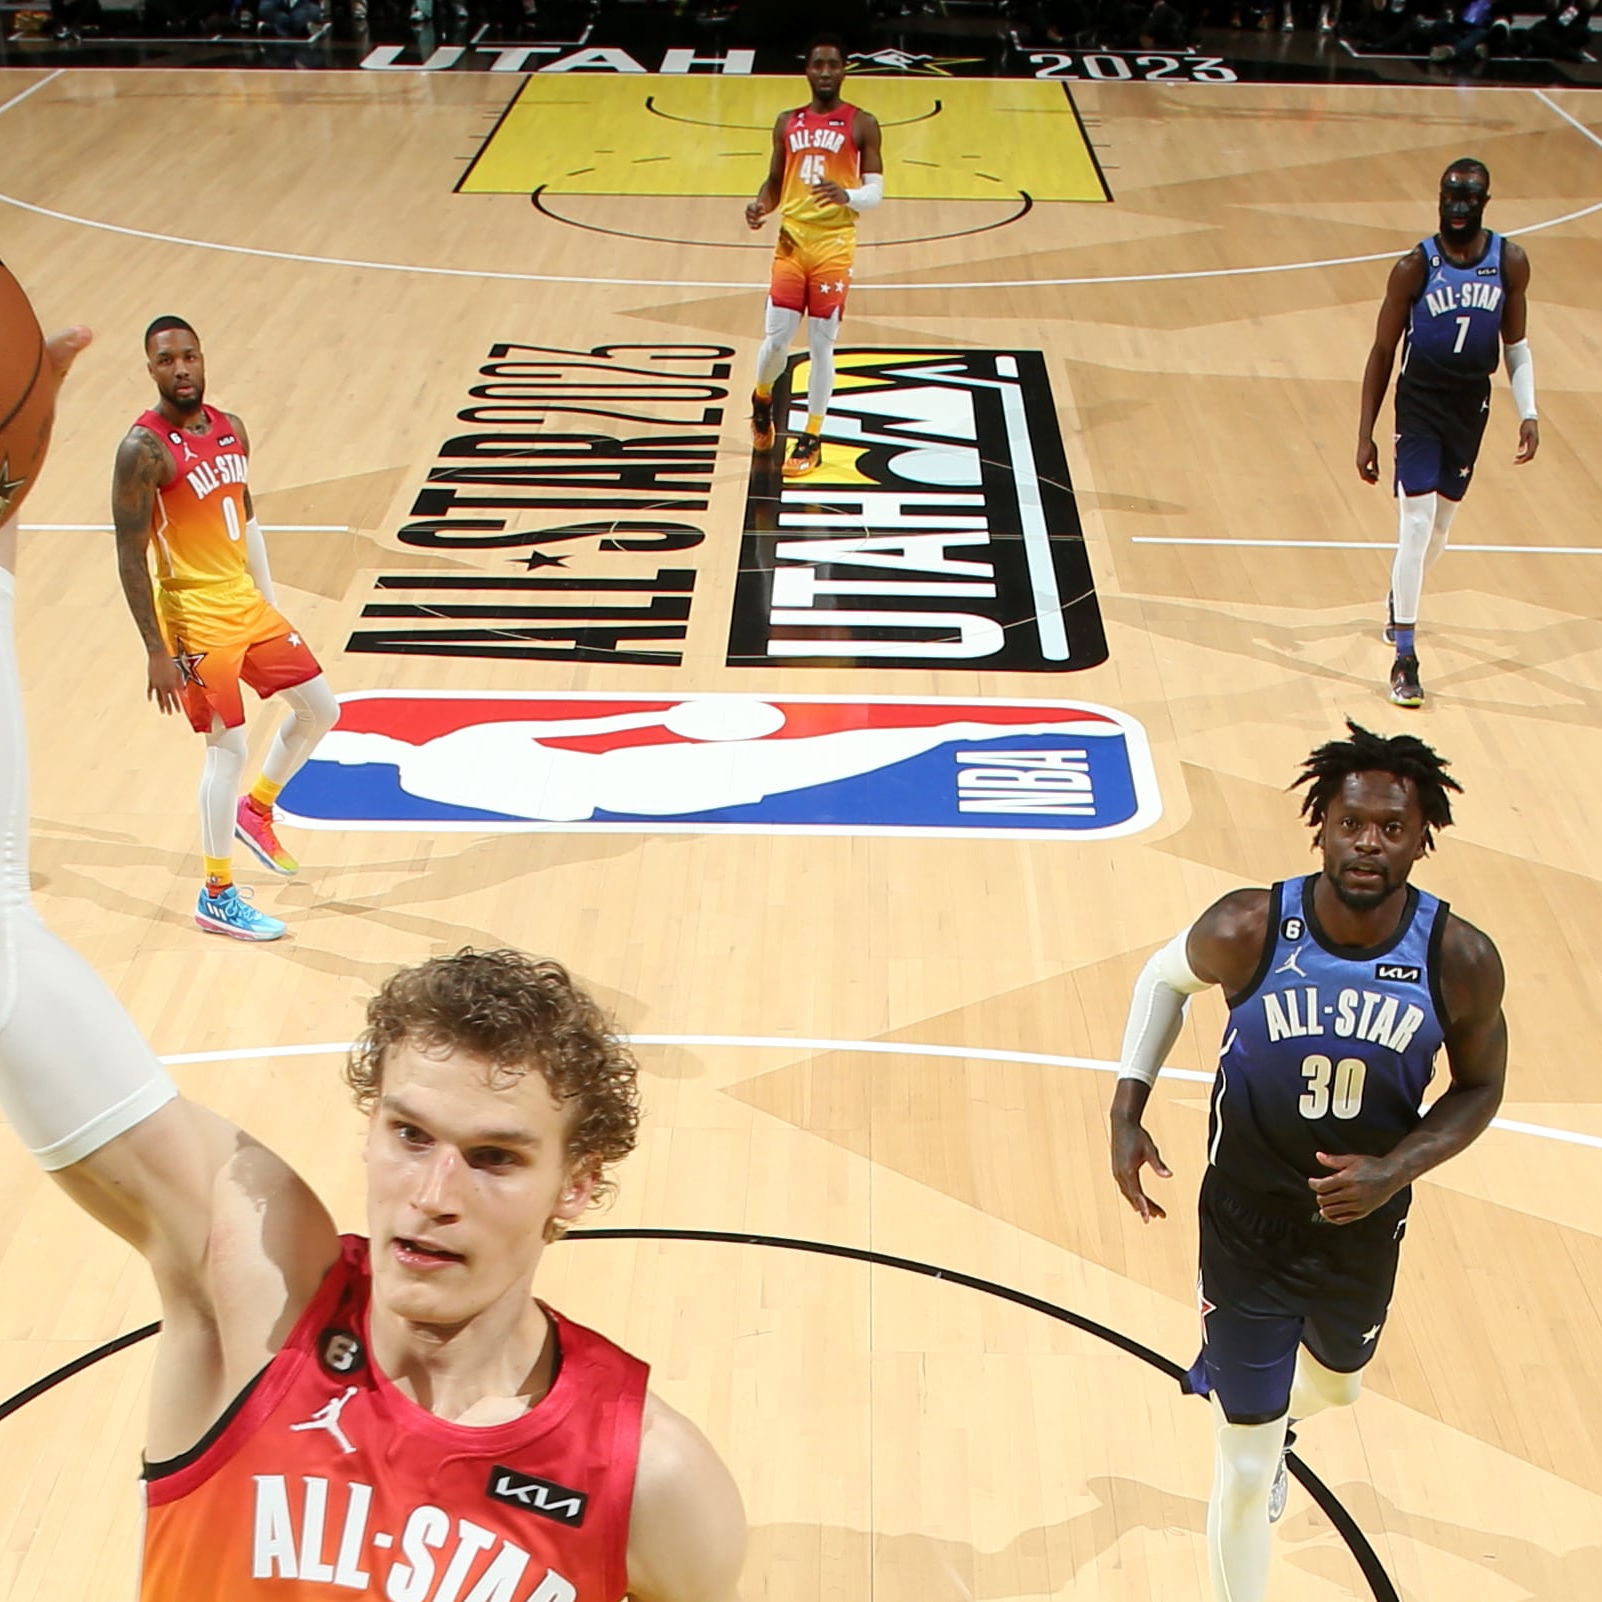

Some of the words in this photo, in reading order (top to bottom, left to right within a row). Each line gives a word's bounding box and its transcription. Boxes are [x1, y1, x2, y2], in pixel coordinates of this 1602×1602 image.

[360, 45, 756, 74] UTAH
[1029, 54, 1238, 82] 2023
[799, 154, 826, 185] 45
[1453, 316, 1471, 353] 7
[222, 496, 241, 541] 0
[767, 490, 1005, 658] UTAH
[956, 750, 1096, 816] NBA
[1285, 920, 1301, 939] 6
[1262, 987, 1425, 1054] ALL-STAR
[1298, 1054, 1367, 1119] 30
[324, 1335, 360, 1371] 6
